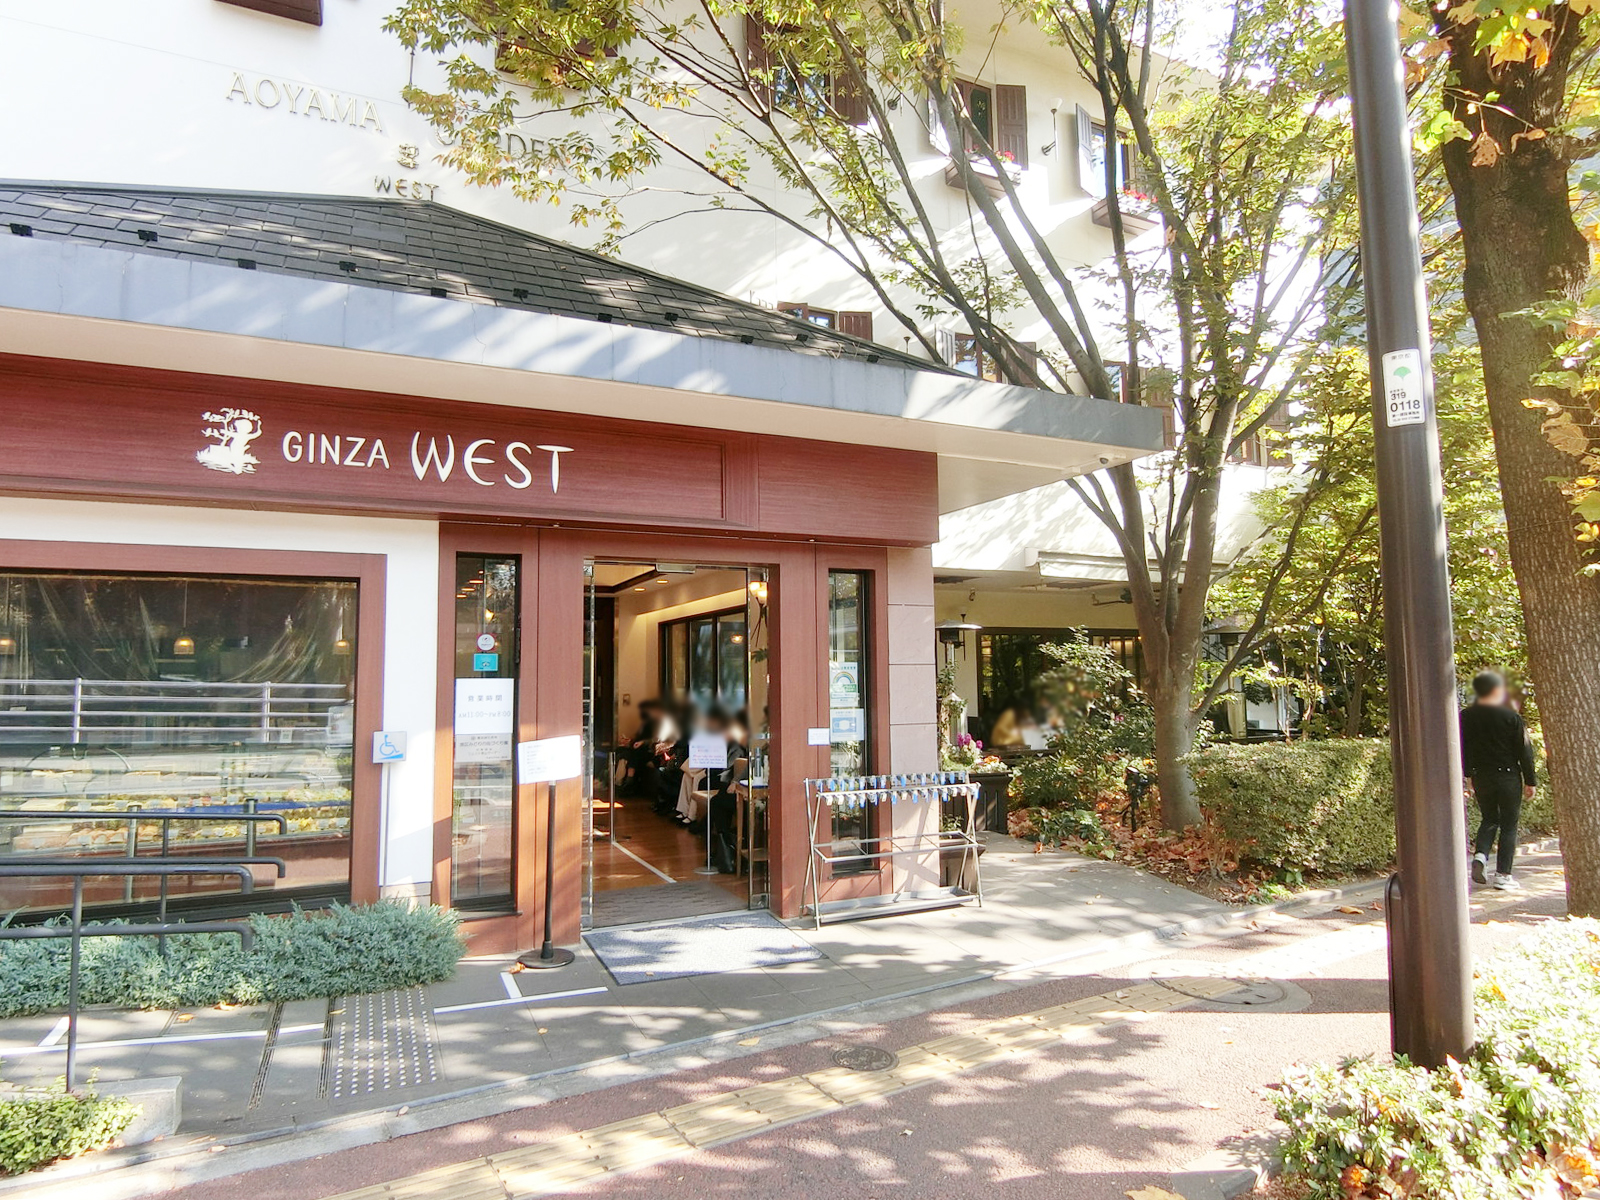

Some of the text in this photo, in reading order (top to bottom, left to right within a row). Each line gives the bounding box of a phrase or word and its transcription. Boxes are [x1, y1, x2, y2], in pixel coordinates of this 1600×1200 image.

[226, 71, 383, 132] AOYAMA
[374, 175, 440, 201] WEST
[1390, 400, 1420, 412] 0118
[1391, 392, 1406, 400] 319
[282, 430, 575, 494] GINZA WEST
